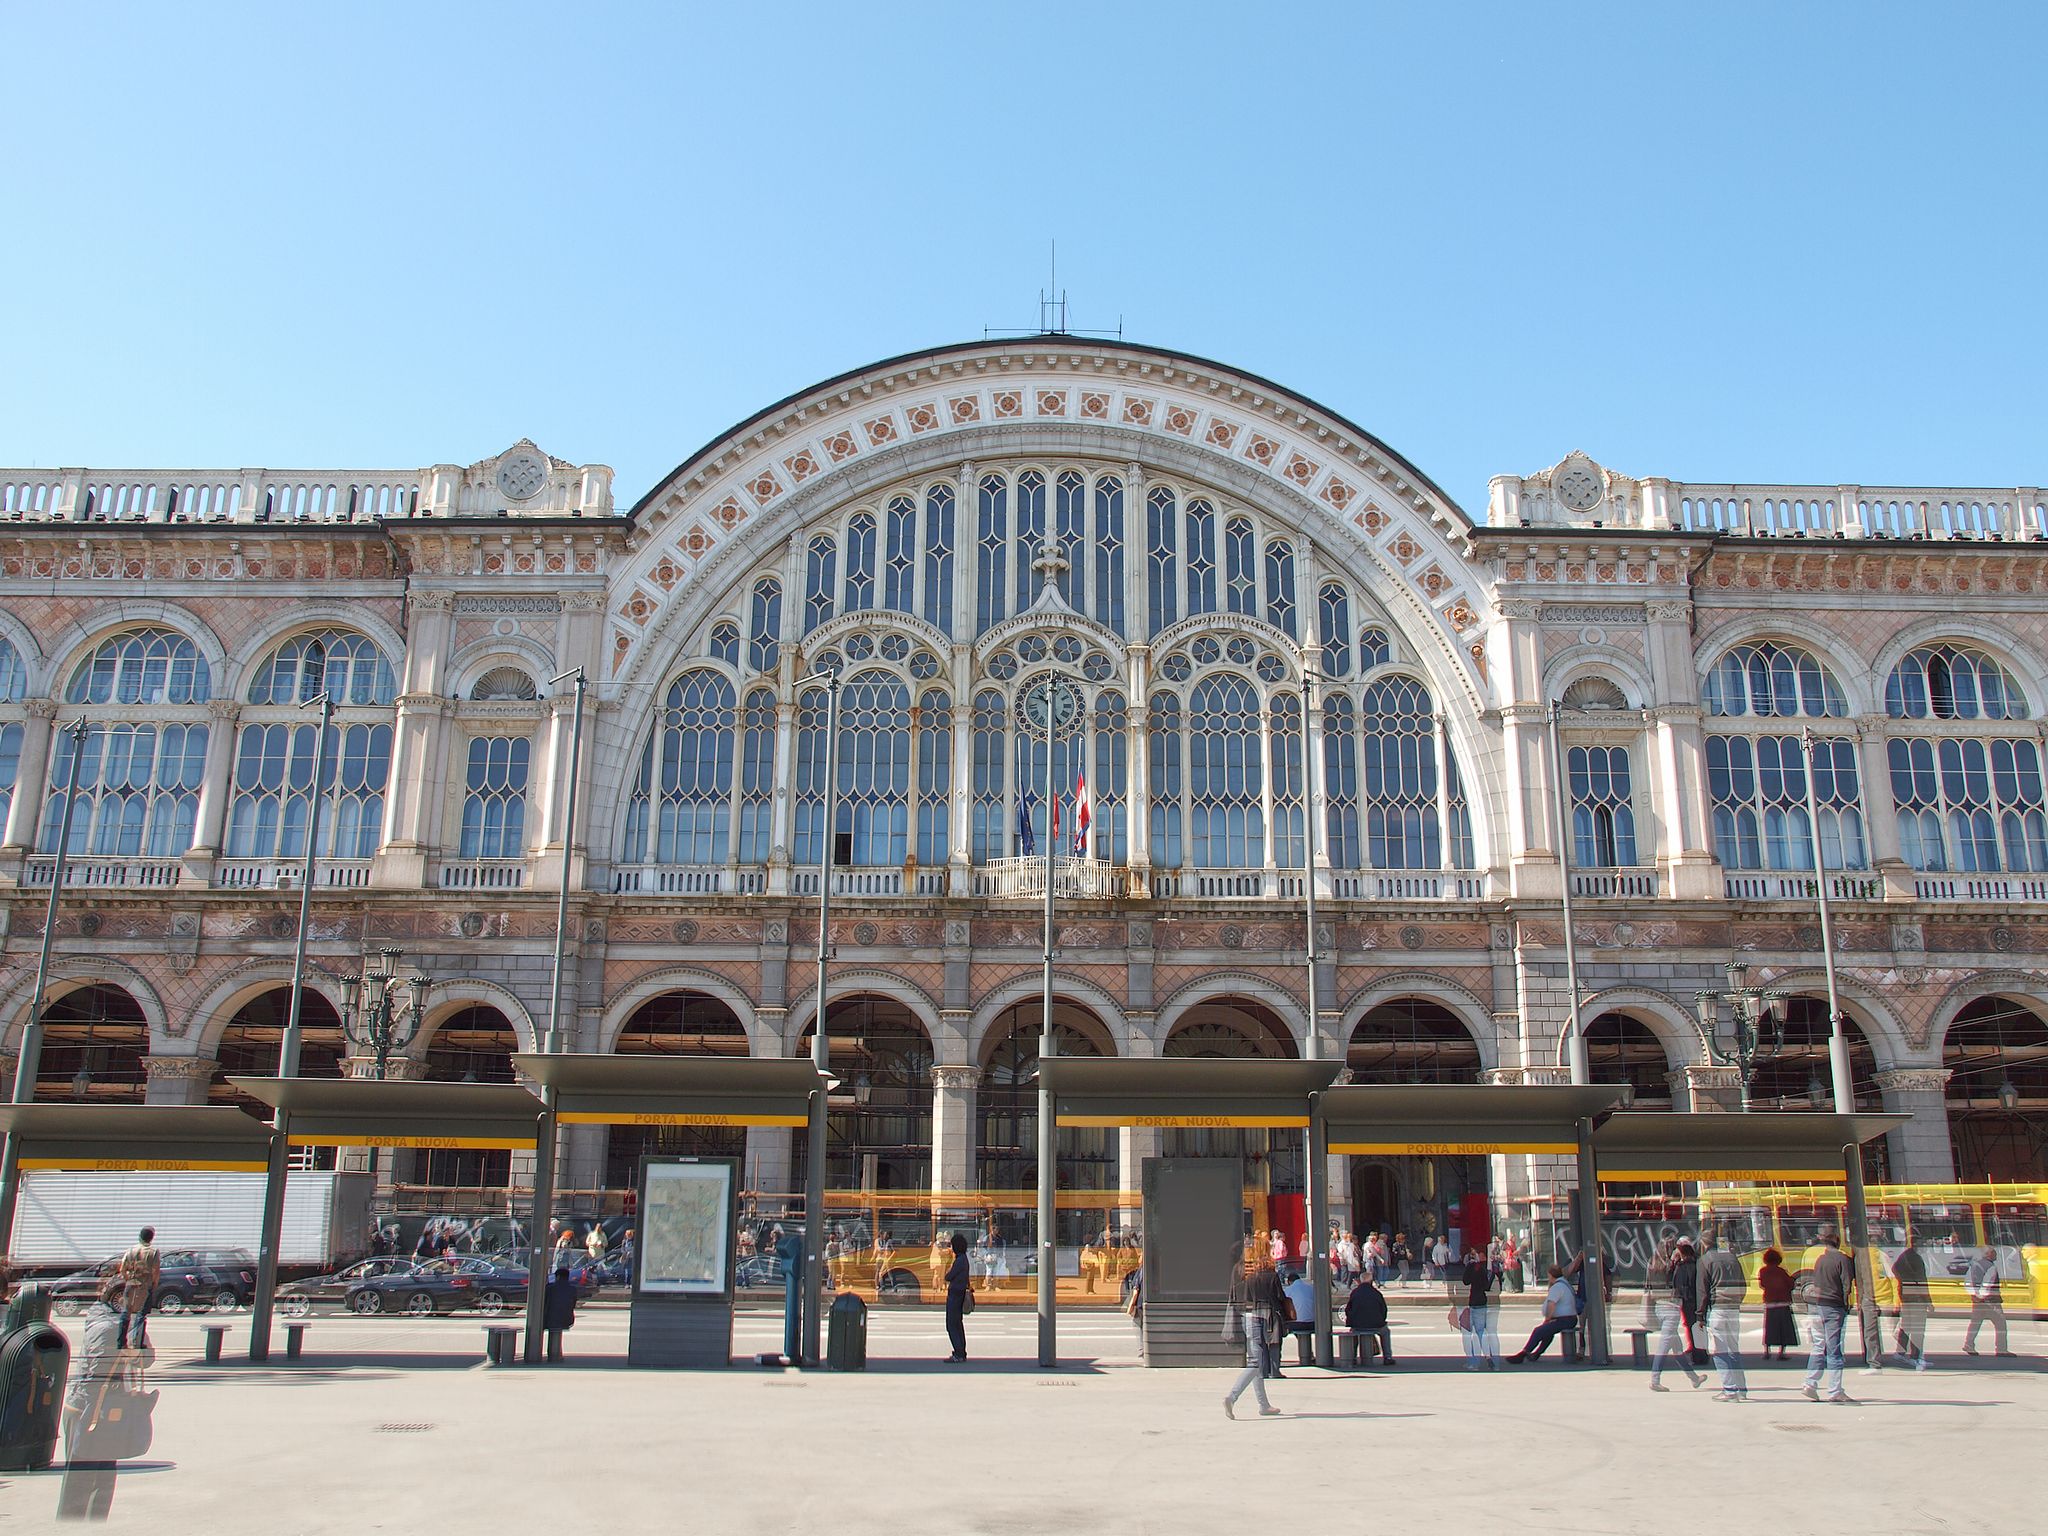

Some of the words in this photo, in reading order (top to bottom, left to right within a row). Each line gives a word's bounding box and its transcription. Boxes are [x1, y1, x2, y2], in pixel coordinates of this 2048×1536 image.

[634, 1114, 677, 1124] PORTA
[684, 1115, 729, 1125] NUOVA
[1135, 1116, 1178, 1126] PORTA
[1186, 1117, 1231, 1127] NUOVA
[365, 1136, 408, 1146] PORTA
[415, 1137, 459, 1148] NUOVA
[1406, 1143, 1450, 1154] PORTA
[1457, 1143, 1502, 1154] NUOVA
[96, 1160, 138, 1170] PORTA
[145, 1160, 190, 1171] NUOVA
[1675, 1170, 1718, 1180] PORTA
[1725, 1170, 1769, 1180] NUOVA
